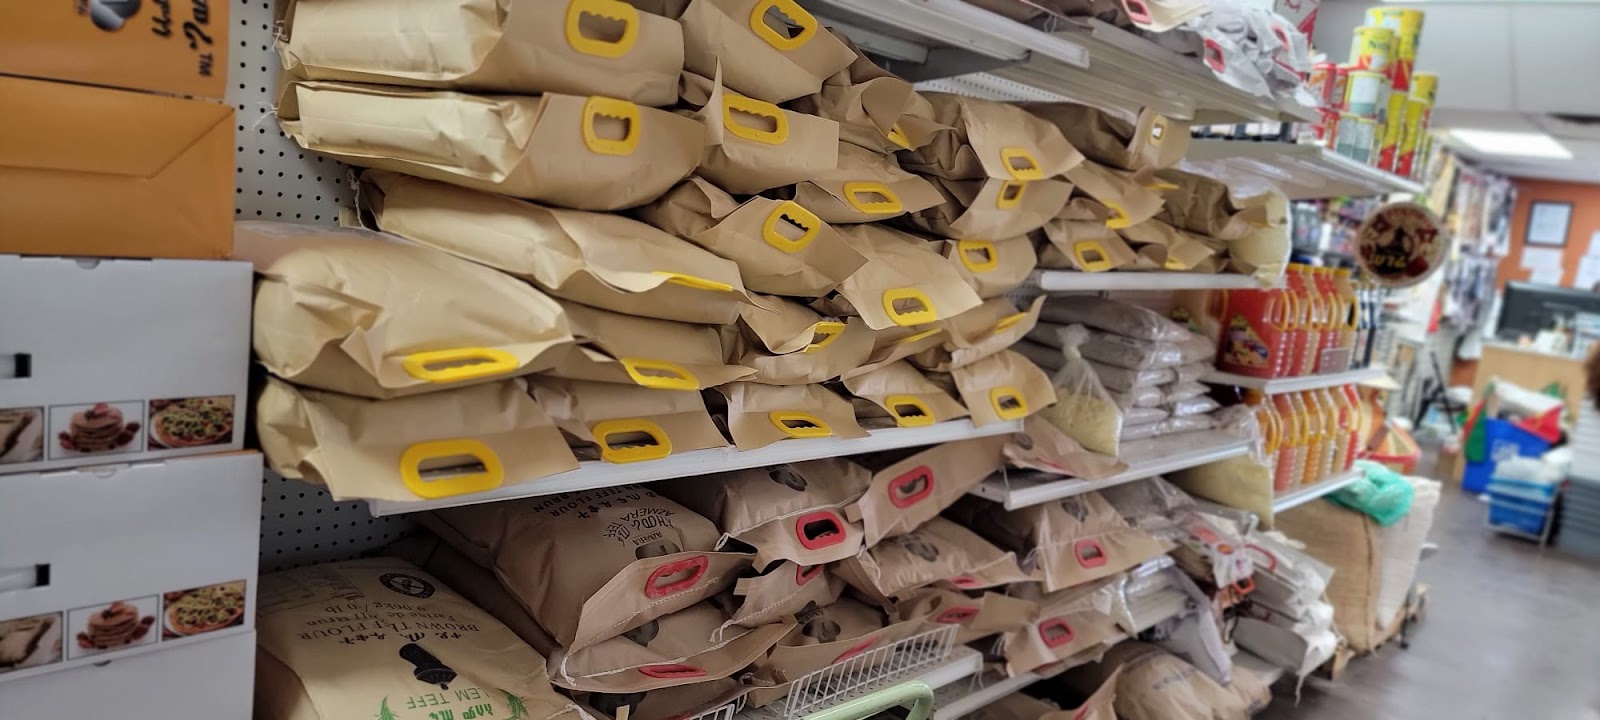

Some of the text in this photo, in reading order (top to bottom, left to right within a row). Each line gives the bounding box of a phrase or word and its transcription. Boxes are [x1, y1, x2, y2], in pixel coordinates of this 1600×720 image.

[595, 486, 623, 499] TEFF
[549, 495, 593, 517] FLOUR
[620, 507, 676, 522] AZMERA
[386, 611, 405, 619] de
[296, 622, 368, 641] FLOUR
[415, 621, 480, 632] BROWN
[406, 692, 450, 709] TEFF
